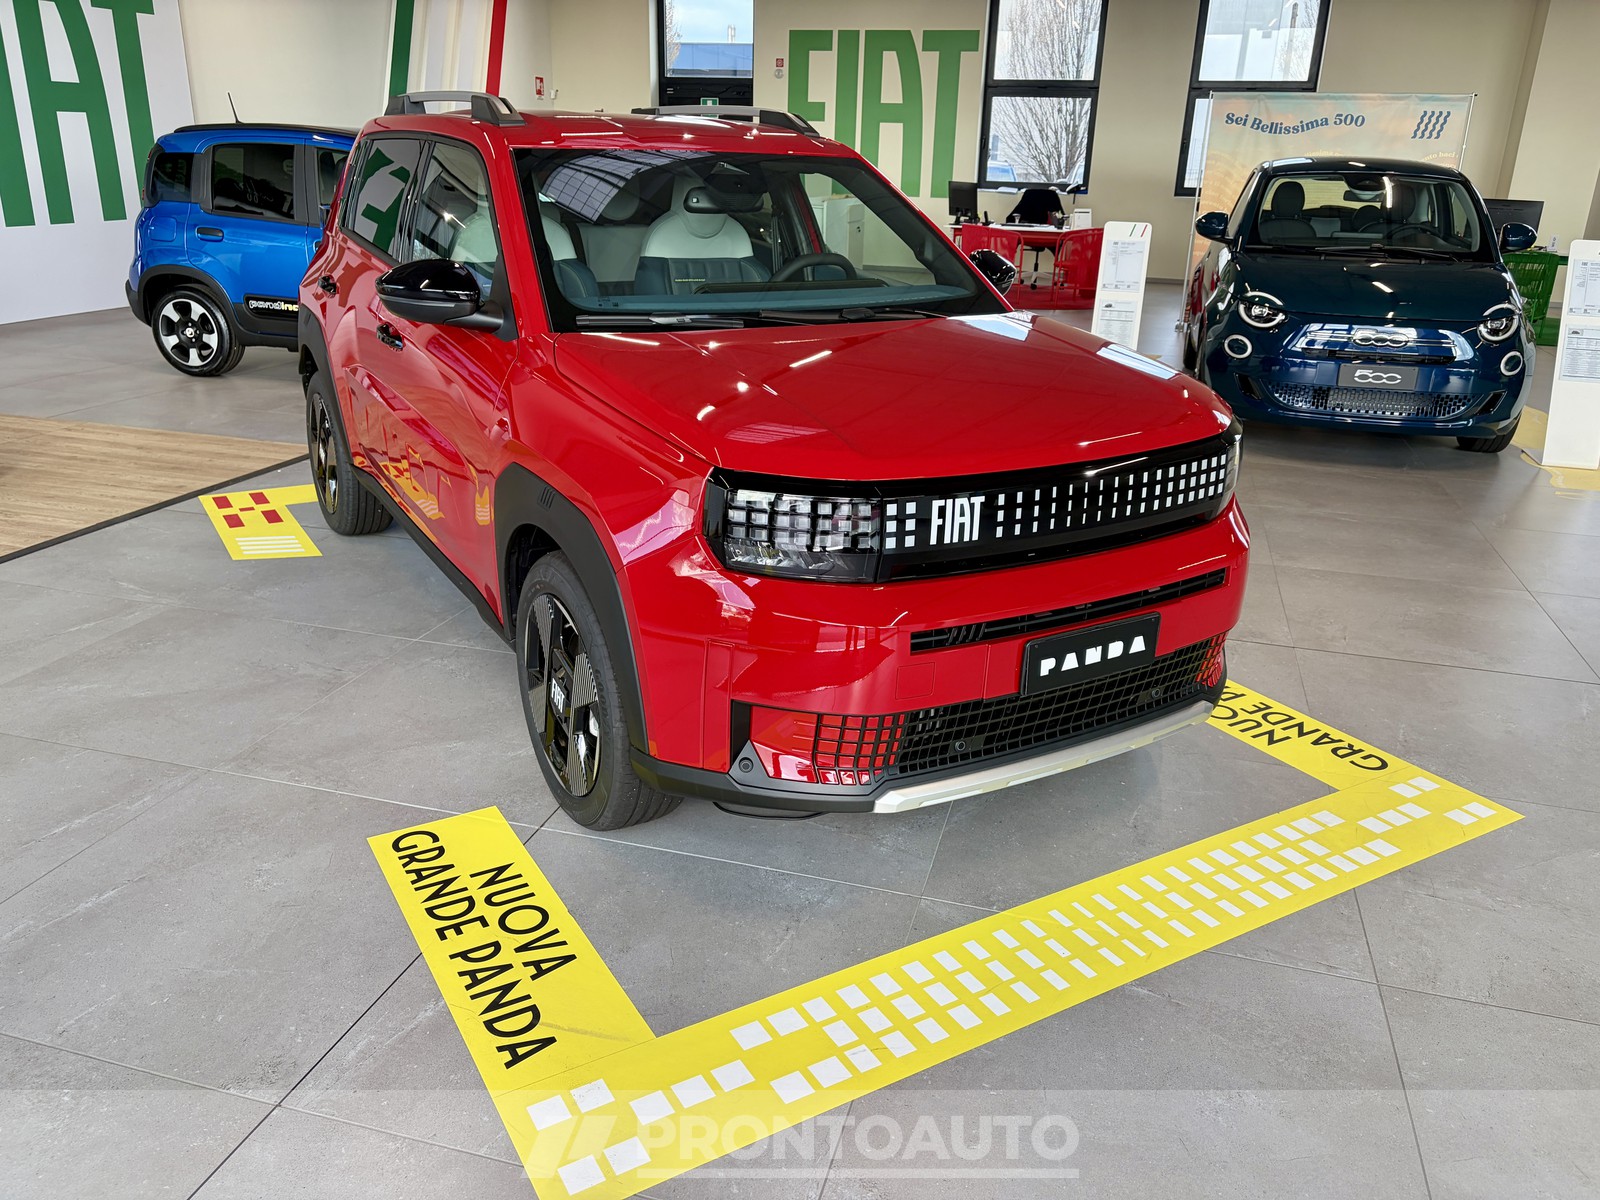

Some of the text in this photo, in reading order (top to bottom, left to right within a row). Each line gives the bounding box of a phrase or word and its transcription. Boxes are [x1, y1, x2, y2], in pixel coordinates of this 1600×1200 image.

[787, 29, 981, 198] FIAT
[1225, 112, 1366, 135] Sei Bellissima 500
[1353, 328, 1409, 348] 500
[1354, 369, 1402, 385] 500
[929, 496, 986, 546] FIAT
[1039, 635, 1146, 677] PANDA
[551, 677, 565, 714] FIAT
[1210, 704, 1292, 746] NUO
[1239, 701, 1389, 771] GRANDE
[469, 861, 578, 981] NUOVA
[391, 830, 558, 1070] GRANDE PANDA
